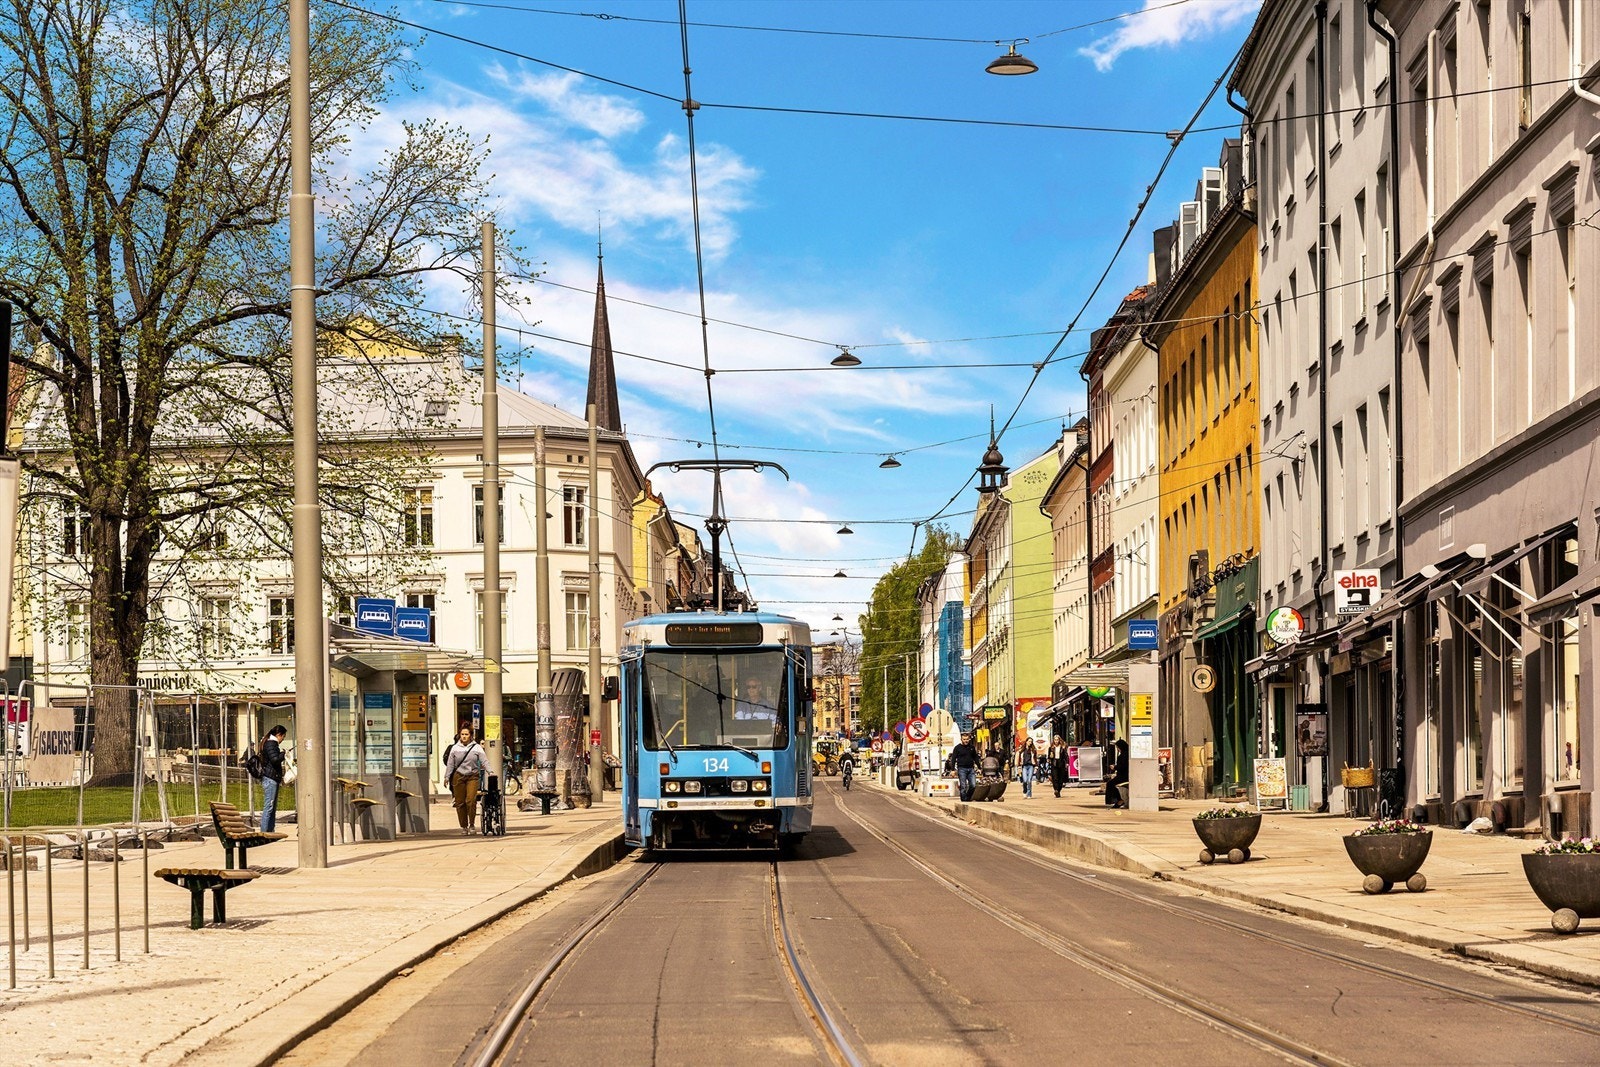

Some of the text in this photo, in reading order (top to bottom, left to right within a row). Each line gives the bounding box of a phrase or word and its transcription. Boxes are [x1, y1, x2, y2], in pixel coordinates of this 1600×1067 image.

[1338, 572, 1377, 589] elna
[138, 673, 191, 690] enneriet
[429, 672, 449, 690] RK
[702, 757, 729, 772] 134
